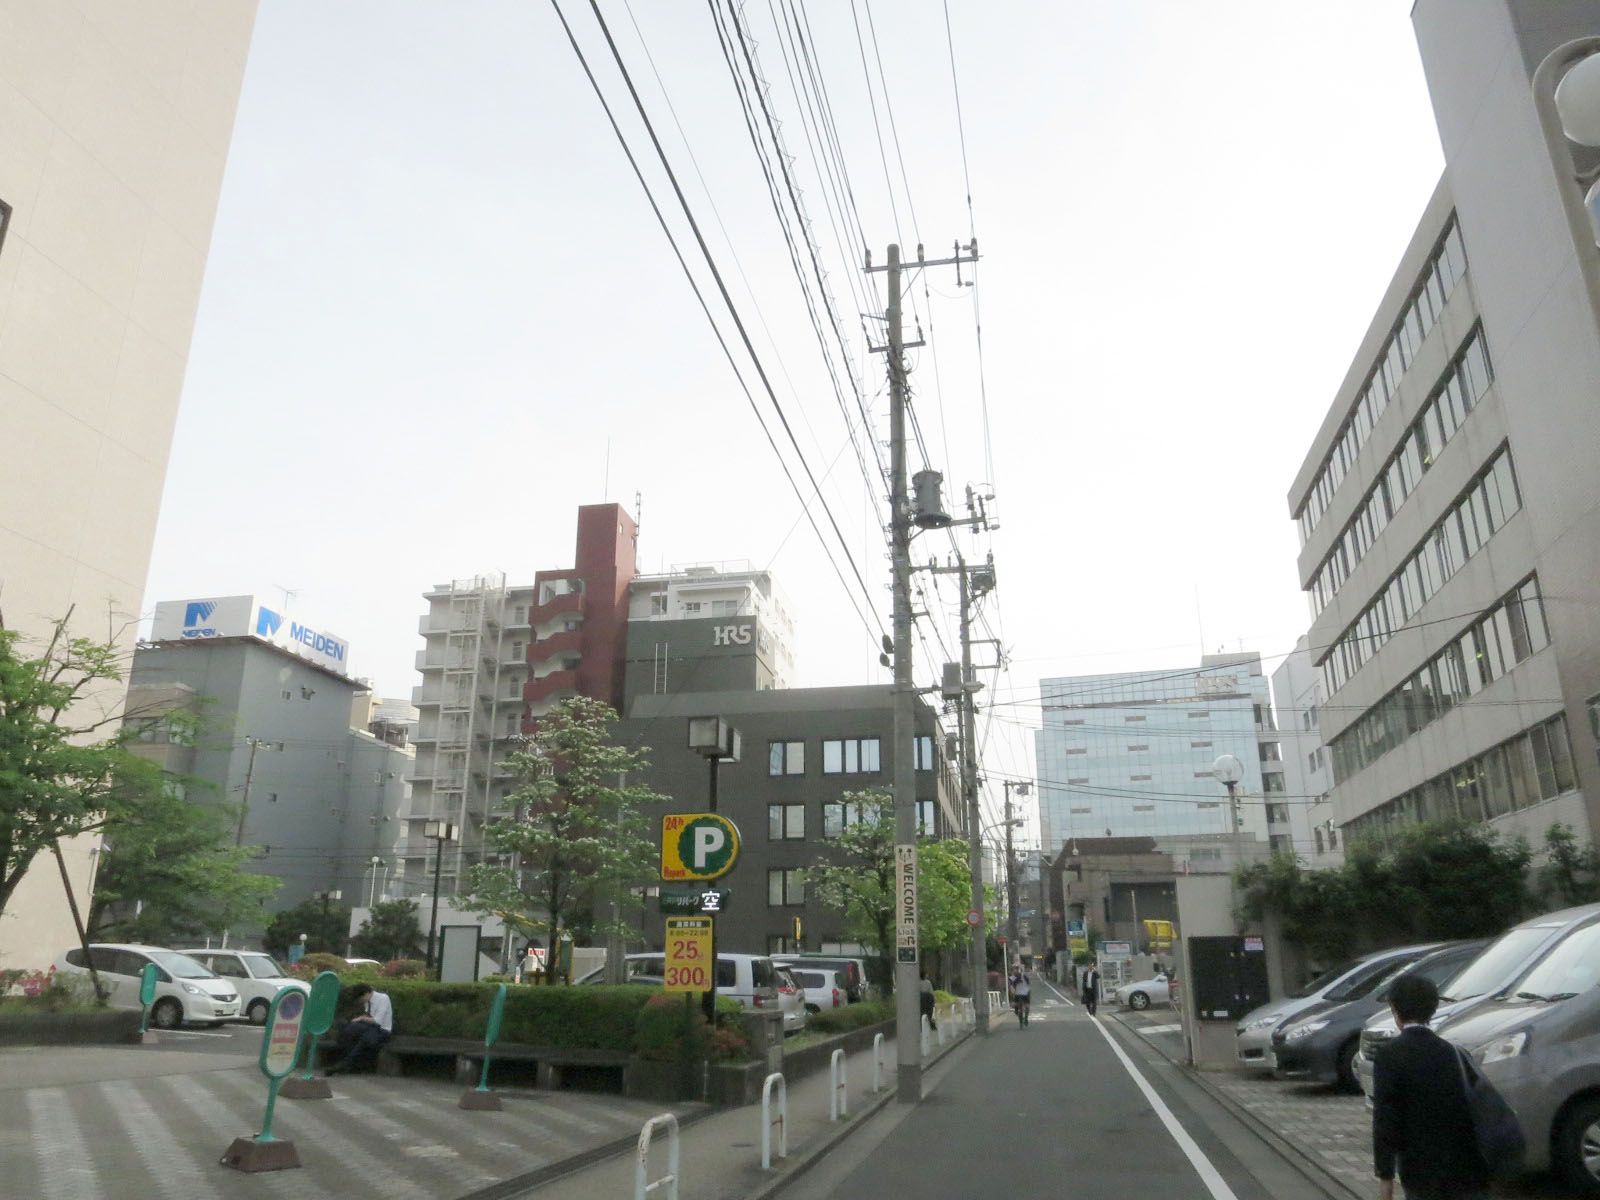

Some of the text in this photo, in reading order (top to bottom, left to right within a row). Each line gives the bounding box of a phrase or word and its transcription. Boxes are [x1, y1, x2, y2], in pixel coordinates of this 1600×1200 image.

[290, 621, 344, 662] MEIDEN
[713, 625, 751, 646] HRS
[694, 826, 725, 869] P
[701, 891, 721, 911] 空
[903, 863, 915, 925] WELCOME
